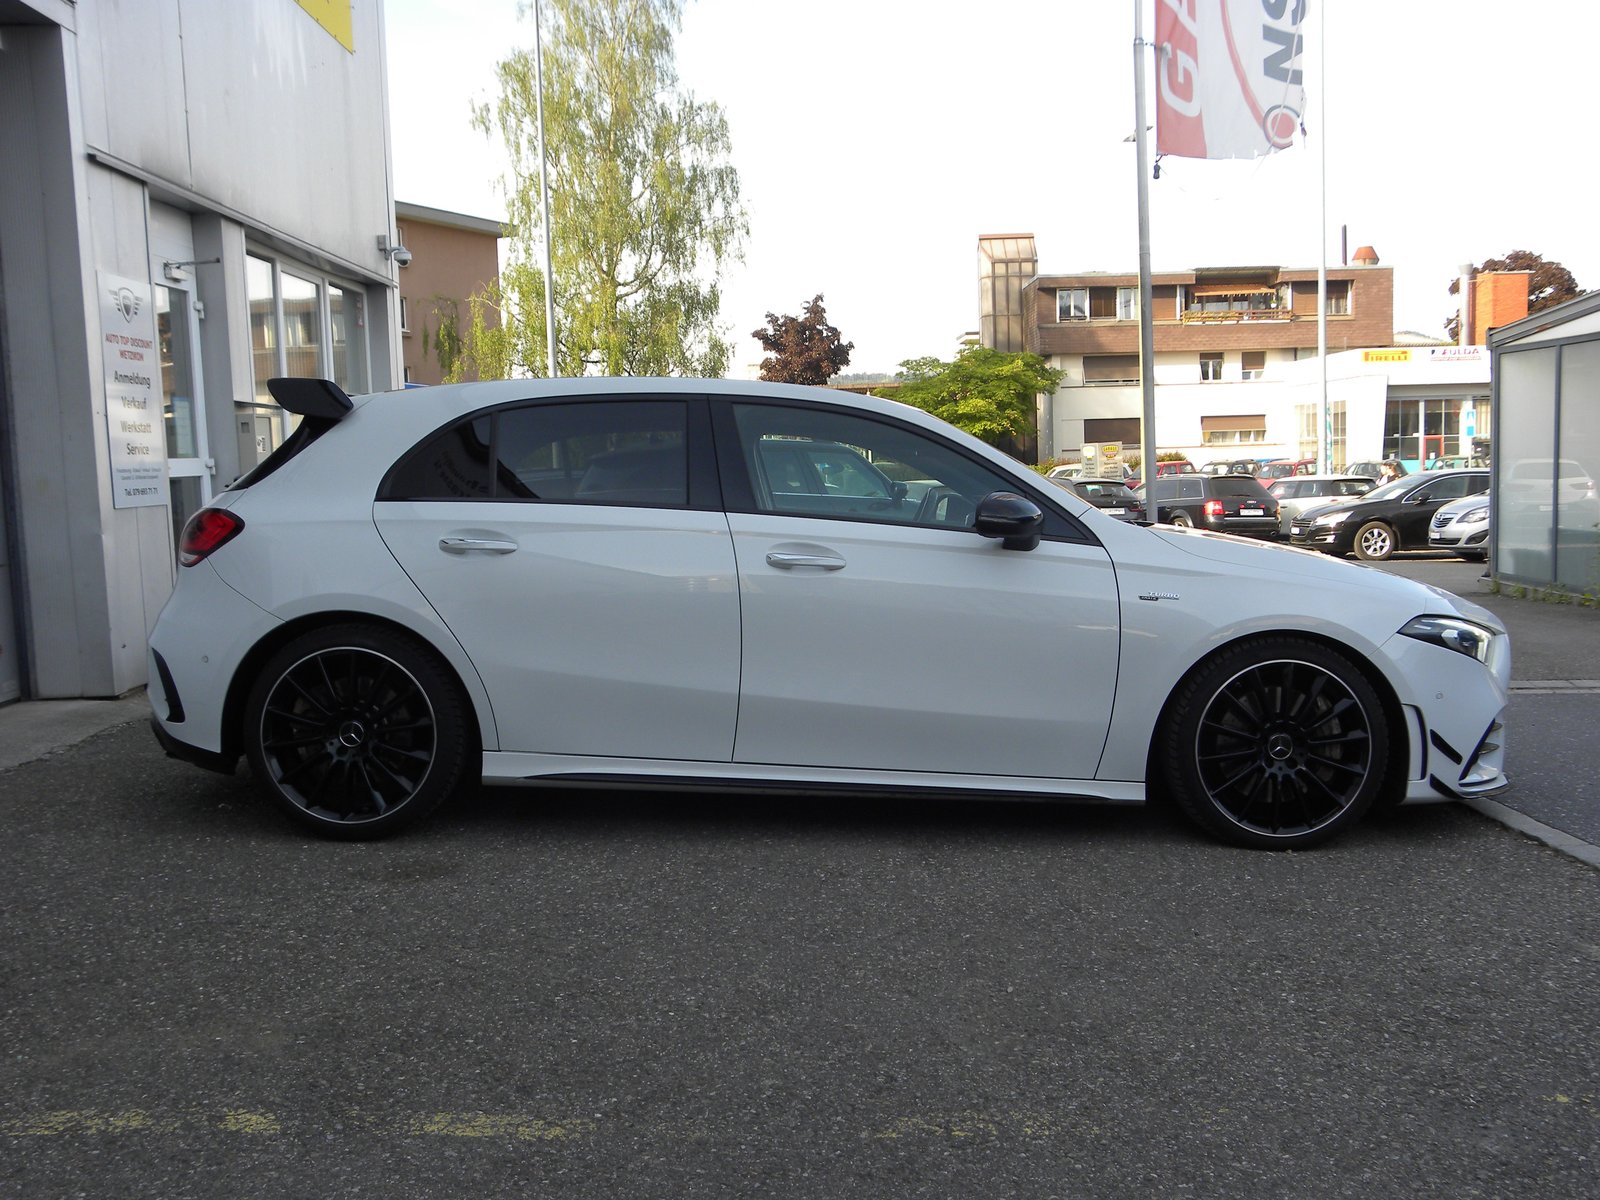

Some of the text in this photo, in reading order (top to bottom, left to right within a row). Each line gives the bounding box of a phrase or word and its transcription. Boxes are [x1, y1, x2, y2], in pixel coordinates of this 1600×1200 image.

[105, 333, 153, 349] AUTO TOP DISCOUNT
[1364, 350, 1408, 361] PIRELLI
[114, 370, 151, 389] Anmeldung
[121, 396, 147, 410] Verkauf
[120, 420, 152, 434] Werkstatt
[126, 443, 150, 455] Service
[1148, 591, 1180, 599] TURBO
